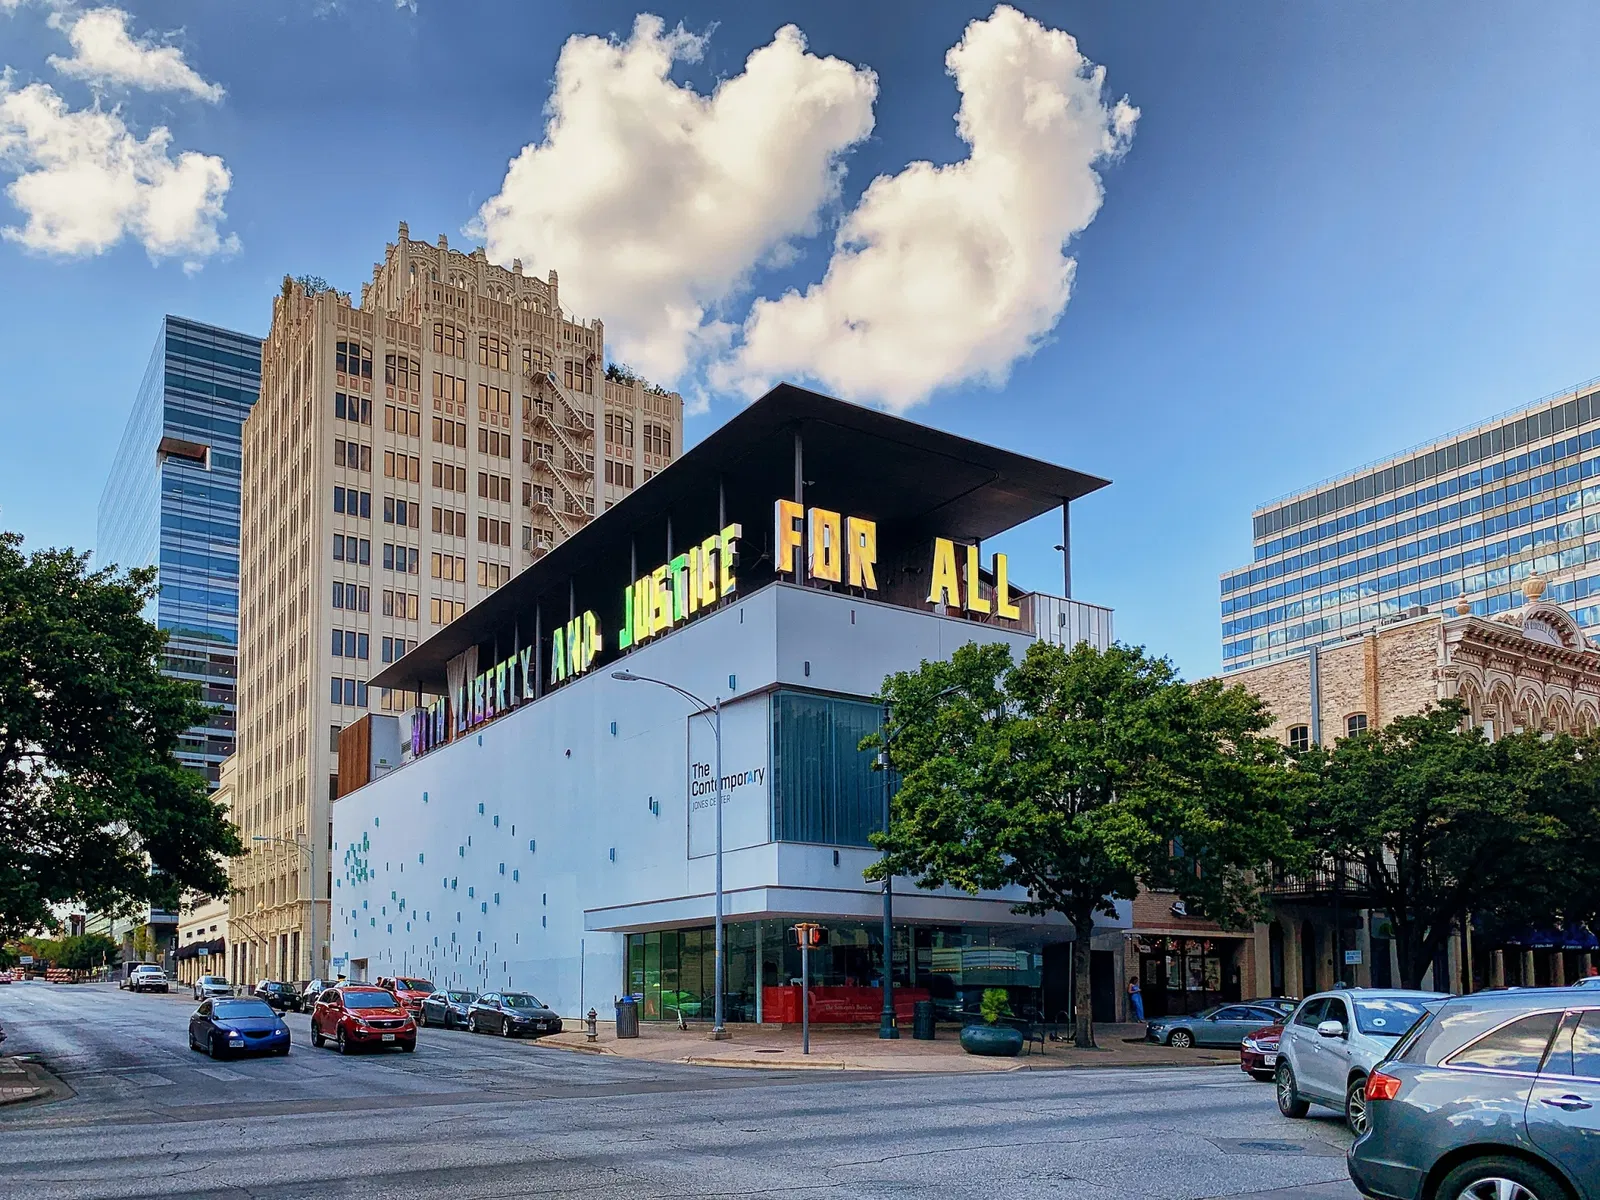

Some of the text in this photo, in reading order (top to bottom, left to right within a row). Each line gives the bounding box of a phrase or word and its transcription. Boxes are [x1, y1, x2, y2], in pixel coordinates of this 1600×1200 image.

[774, 498, 1020, 621] FOR ALL
[411, 523, 742, 757] WITH LIBERTY AND JUSTICE
[692, 762, 710, 779] The
[692, 795, 731, 812] JONES CETER
